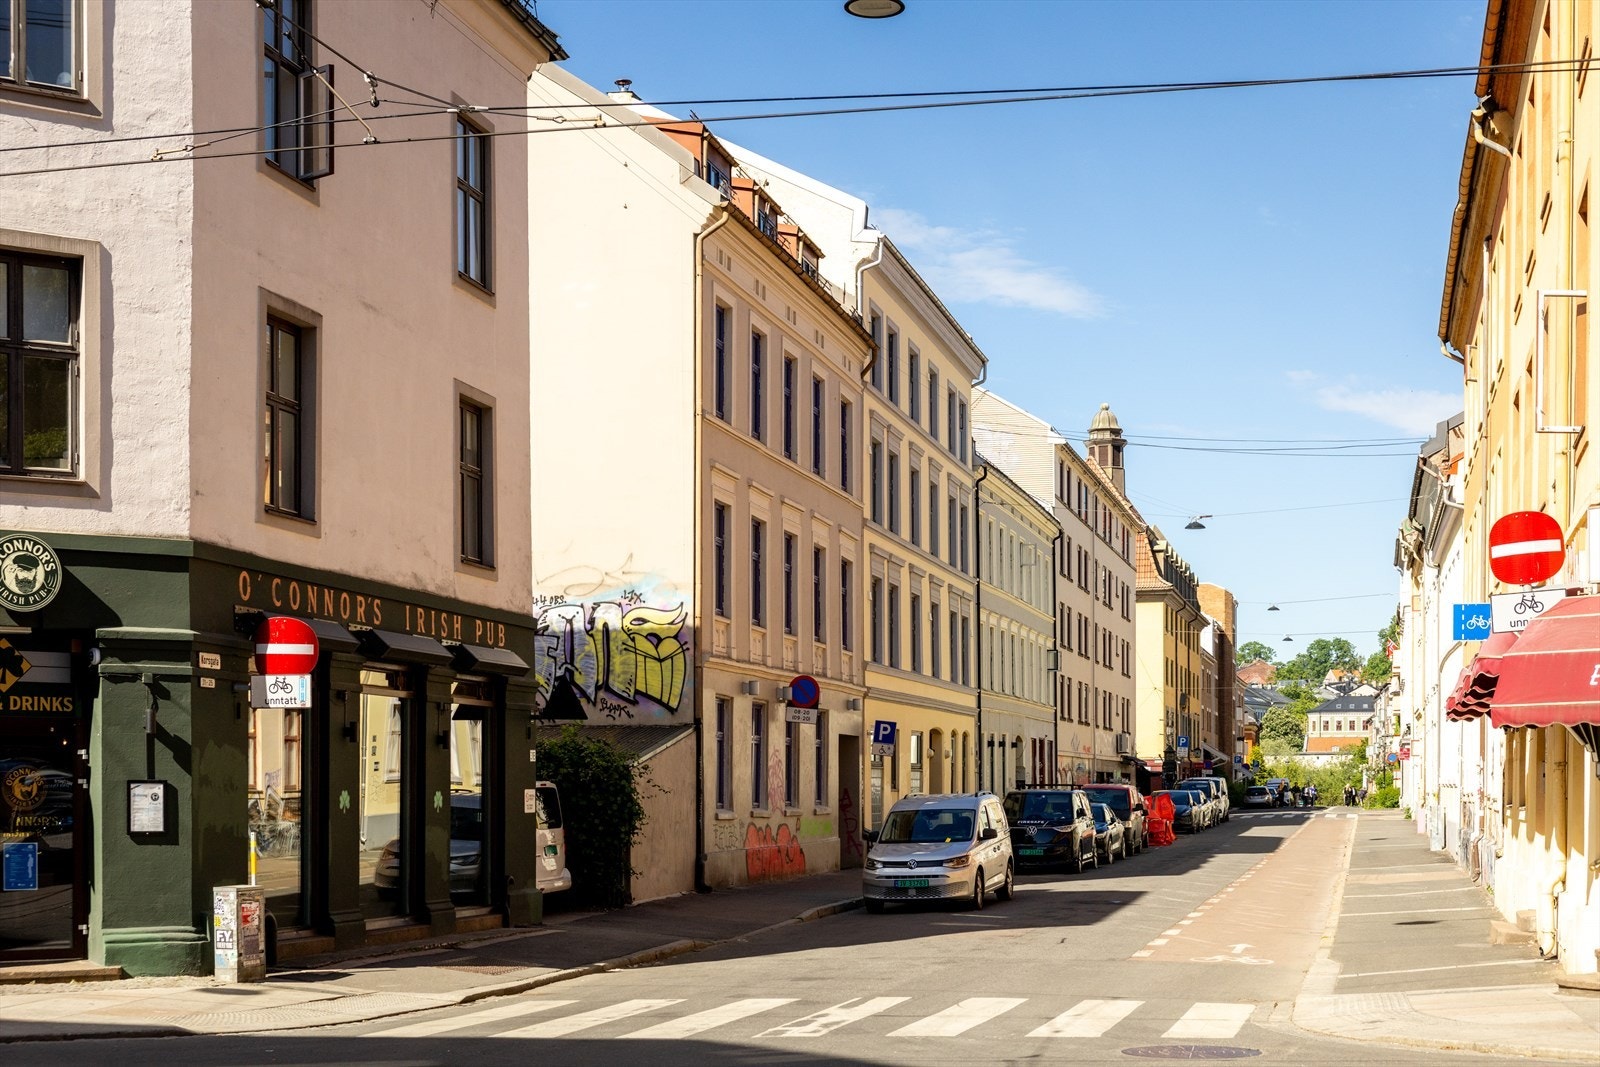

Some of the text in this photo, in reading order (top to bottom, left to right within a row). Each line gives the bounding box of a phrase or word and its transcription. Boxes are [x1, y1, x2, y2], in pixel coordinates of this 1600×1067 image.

[28, 590, 47, 604] PUB
[239, 570, 506, 647] O'CONNOR'S IRISH PUB
[9, 695, 73, 712] DRINKS
[264, 697, 298, 705] unntatt
[879, 723, 891, 741] P
[1180, 737, 1187, 746] P
